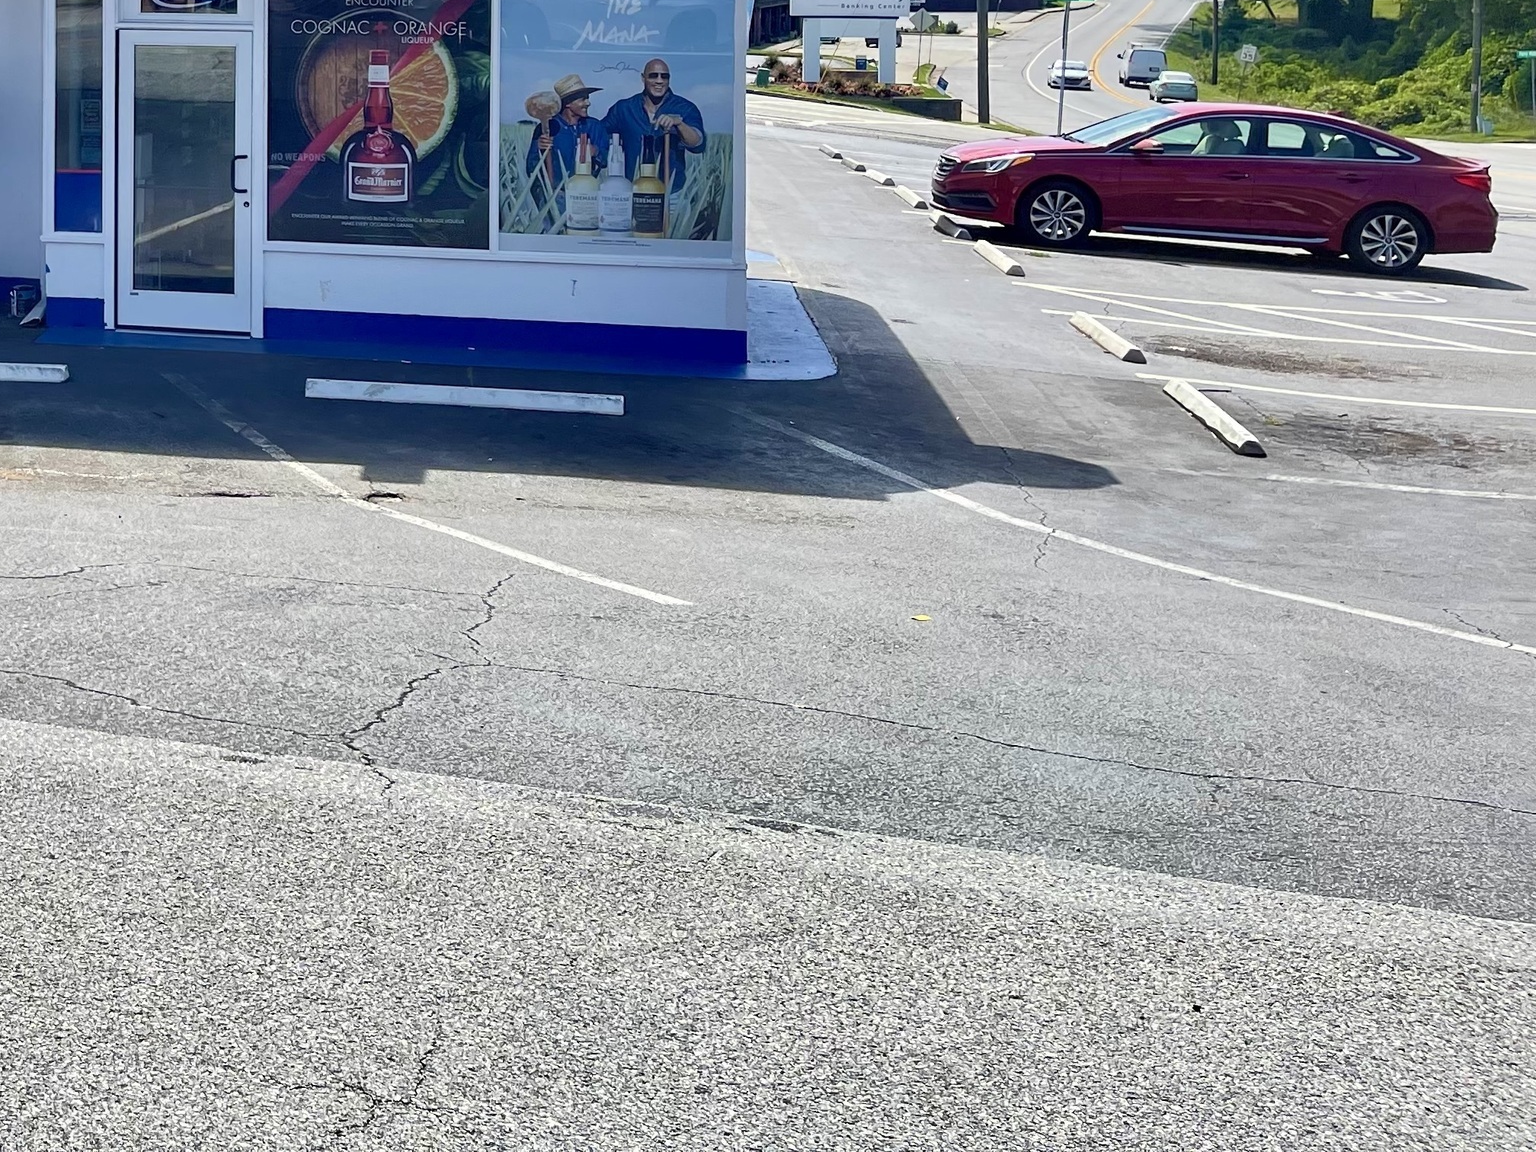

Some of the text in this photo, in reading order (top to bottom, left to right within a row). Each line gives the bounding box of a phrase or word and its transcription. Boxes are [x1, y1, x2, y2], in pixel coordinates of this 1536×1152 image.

[290, 19, 370, 35] COGNAC
[393, 20, 467, 36] ORANGE
[401, 36, 435, 44] LIQUEUR
[572, 19, 660, 51] MANA
[271, 152, 327, 163] NO WEAPONS
